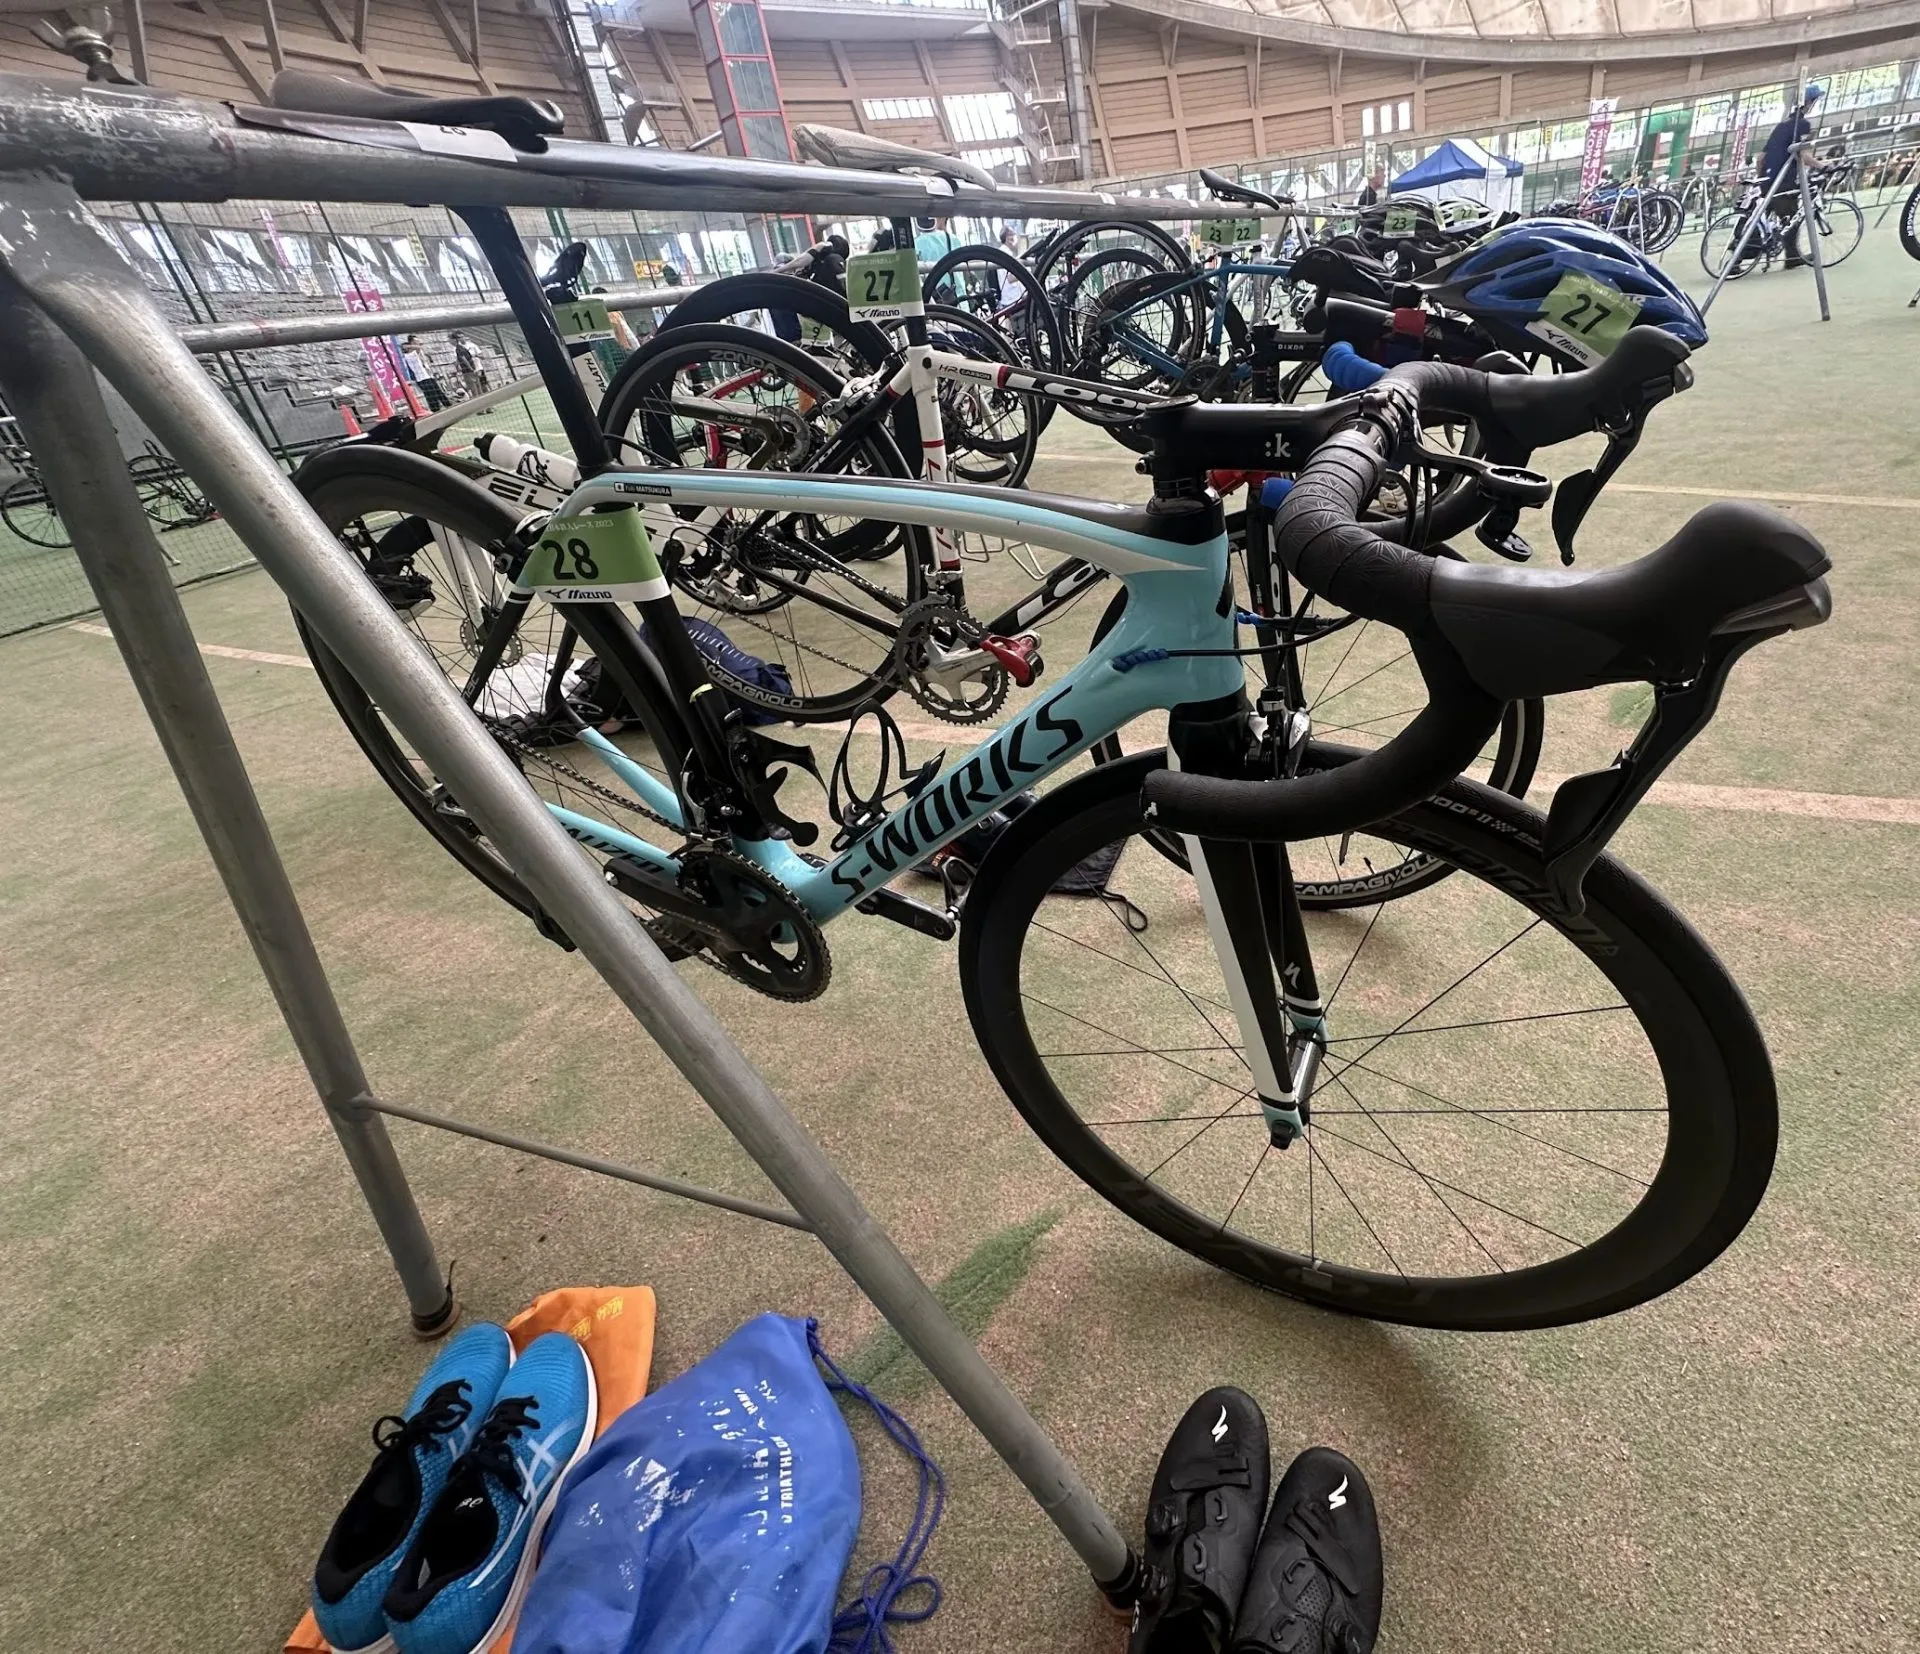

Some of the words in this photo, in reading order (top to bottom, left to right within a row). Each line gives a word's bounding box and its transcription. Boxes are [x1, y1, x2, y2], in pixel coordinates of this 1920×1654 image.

[1209, 227, 1222, 242] 23
[1236, 227, 1251, 241] 22
[1391, 217, 1407, 231] 23
[863, 269, 895, 301] 27
[571, 310, 596, 331] 11
[1561, 293, 1612, 335] 27
[813, 326, 820, 339] 9
[709, 349, 778, 378] ZONDA
[541, 538, 599, 580] 28
[831, 685, 1084, 904] S-WORKS
